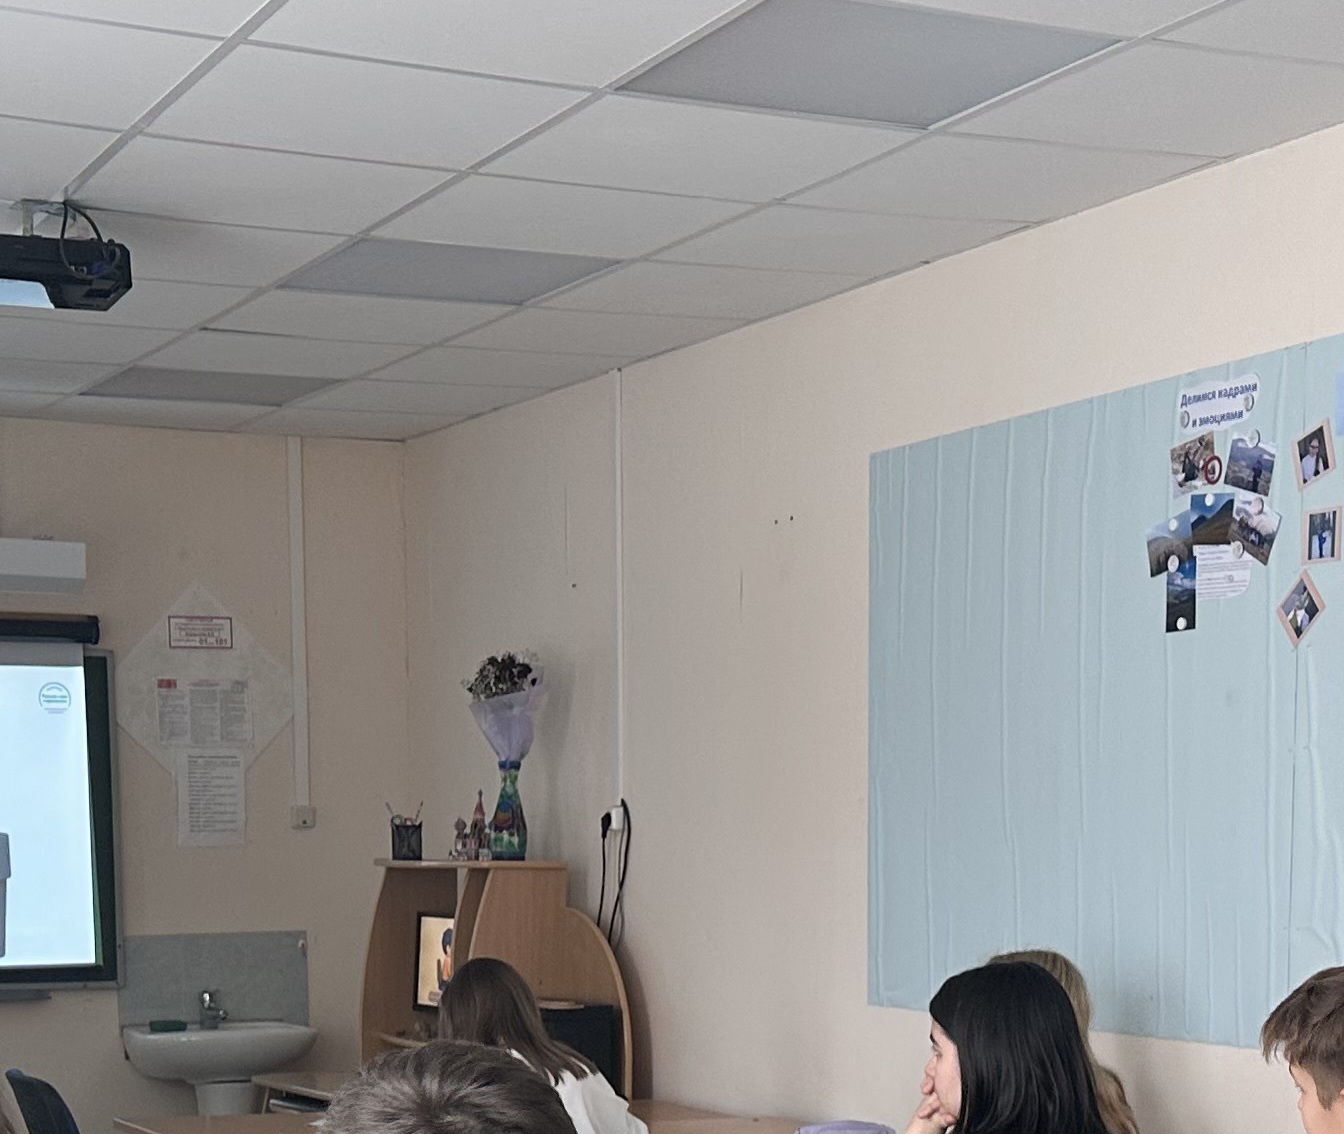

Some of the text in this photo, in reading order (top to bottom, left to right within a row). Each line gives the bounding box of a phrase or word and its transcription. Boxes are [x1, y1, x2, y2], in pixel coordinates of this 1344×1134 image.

[1180, 382, 1258, 408] Делимся кадрами
[1191, 409, 1244, 428] и эмоциями
